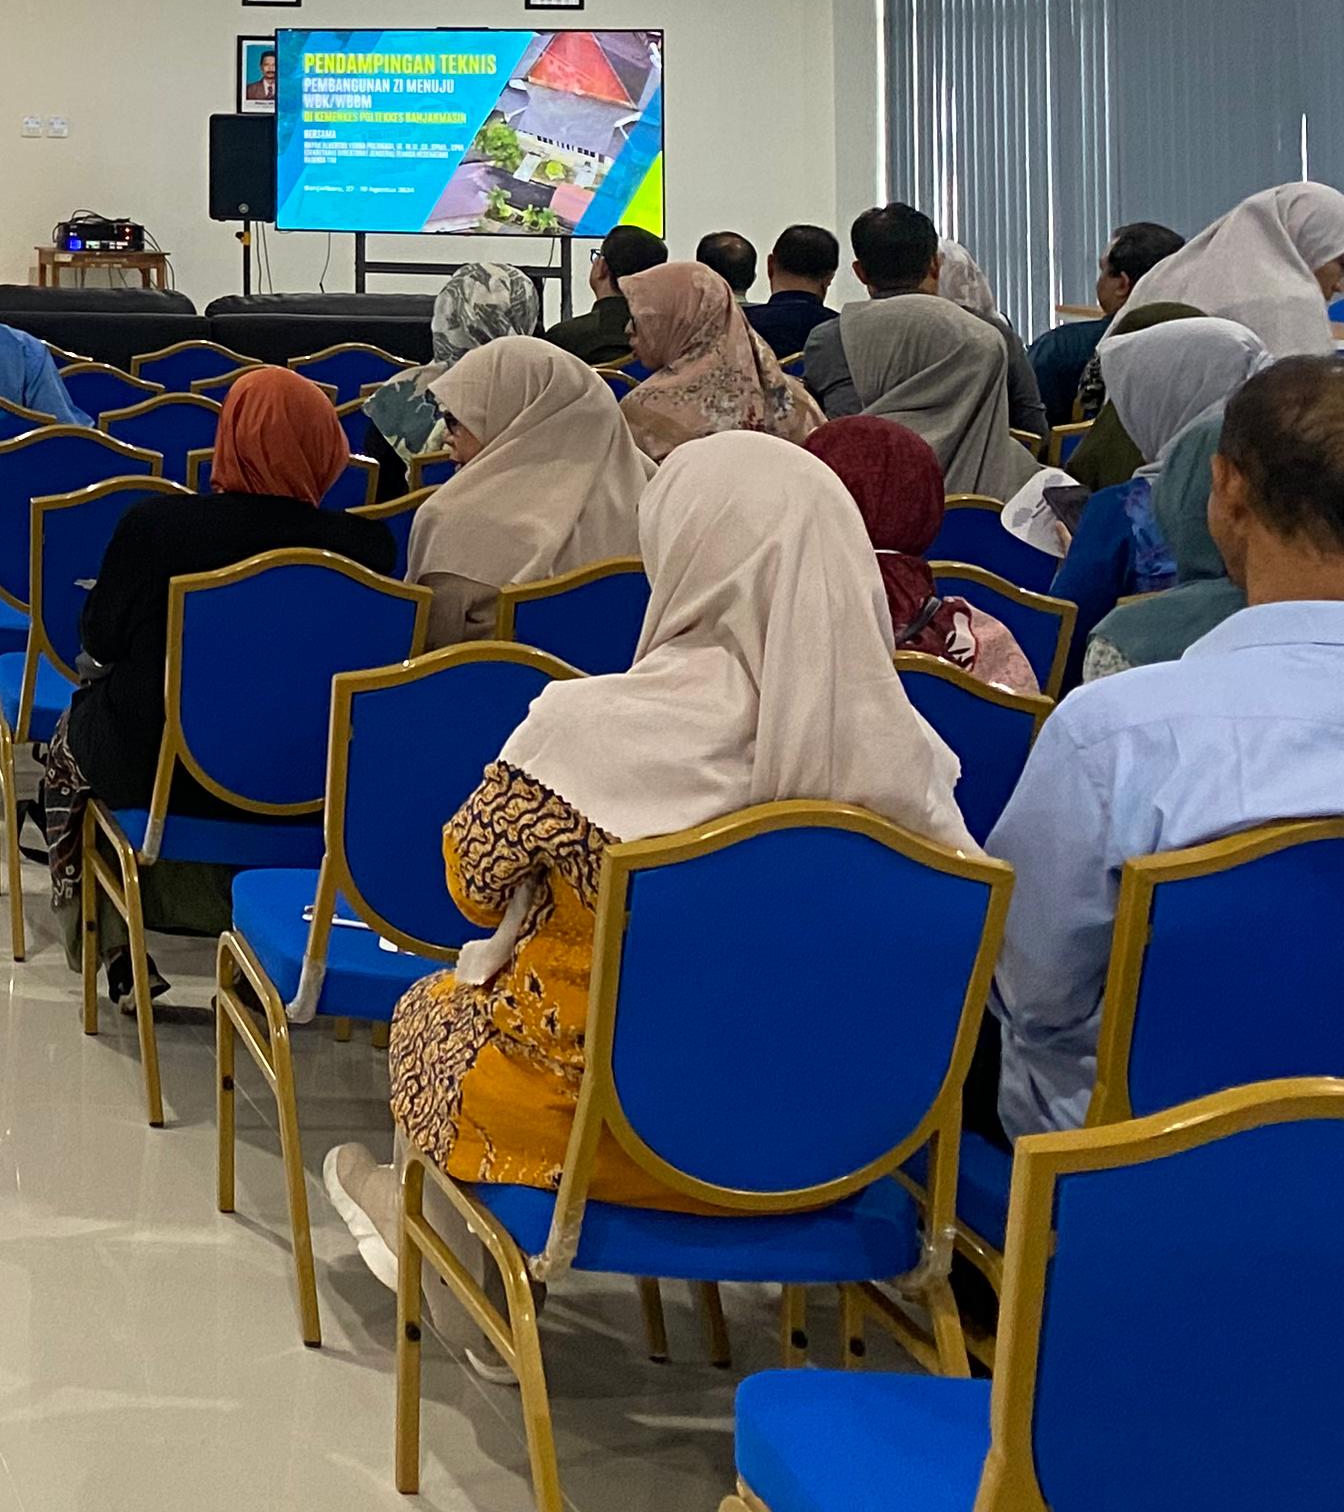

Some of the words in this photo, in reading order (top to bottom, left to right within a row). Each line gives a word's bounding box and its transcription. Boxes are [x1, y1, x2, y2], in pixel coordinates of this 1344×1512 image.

[303, 53, 435, 75] PENDAMPINGAN
[440, 54, 497, 75] TEKNIS
[302, 78, 390, 93] PEMBANGUNAN
[393, 79, 404, 93] ZI
[406, 79, 455, 94] MENUJU
[302, 94, 372, 109] WBK/WBBM
